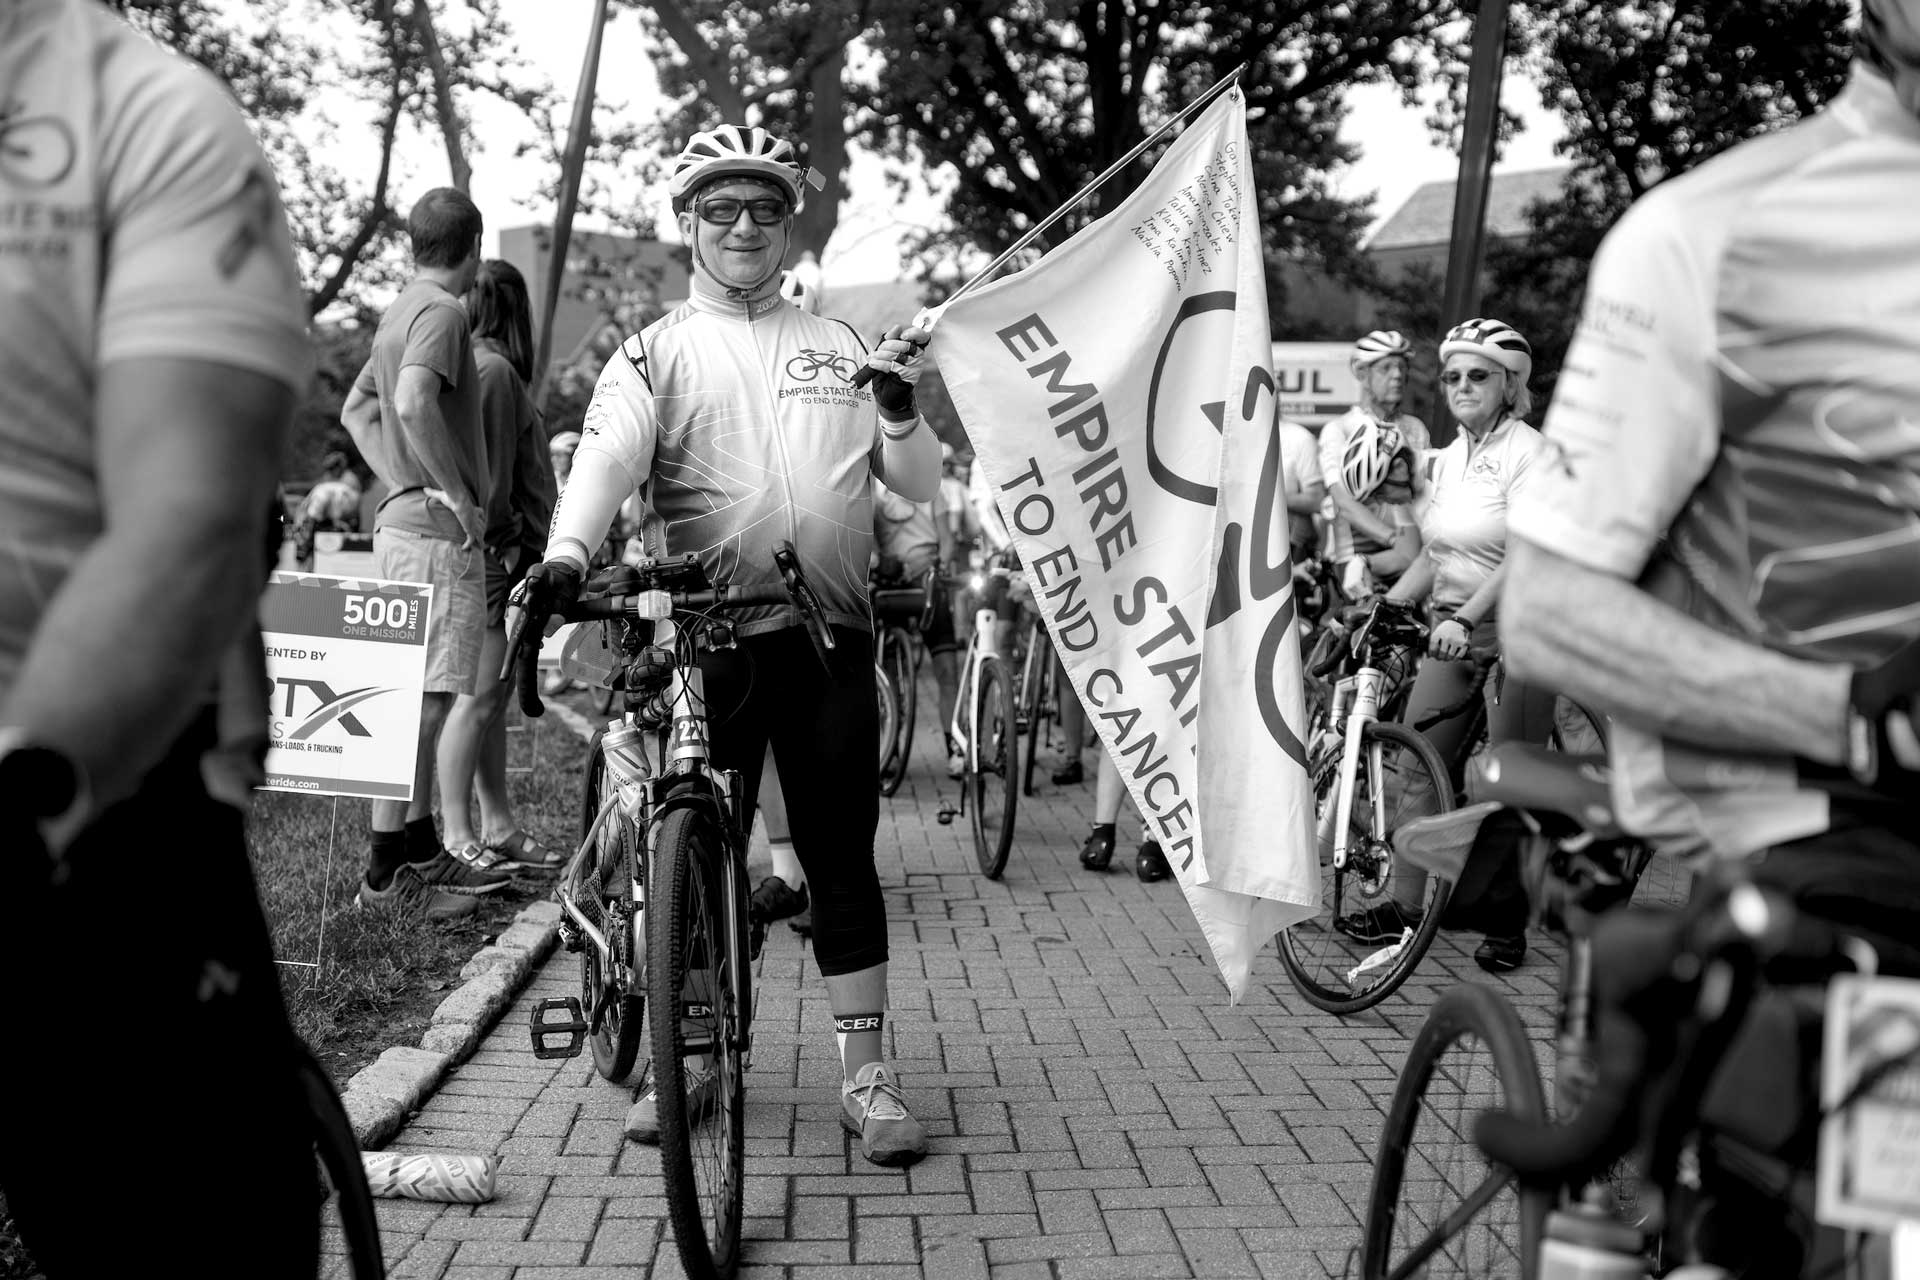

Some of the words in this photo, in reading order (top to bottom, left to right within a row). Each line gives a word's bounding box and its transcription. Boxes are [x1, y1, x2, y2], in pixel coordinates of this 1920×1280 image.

[1131, 226, 1161, 259] Natalia
[1278, 369, 1332, 394] UL
[778, 386, 821, 399] EMPIRE
[823, 386, 852, 397] STATE
[854, 390, 872, 402] RIDE
[801, 397, 812, 405] TO
[814, 397, 831, 405] END
[995, 312, 1137, 573] EMPIRE
[1113, 576, 1201, 757] STA
[1000, 457, 1054, 535] TO
[1032, 544, 1098, 652] END
[343, 594, 409, 628] 500
[408, 599, 419, 630] MILES
[343, 625, 367, 636] ONE
[369, 628, 416, 640] MISSION
[266, 647, 306, 659] ENTED
[310, 649, 327, 661] BY
[313, 744, 343, 754] TRUCKING
[688, 1005, 714, 1017] EN
[834, 1017, 879, 1030] NCER
